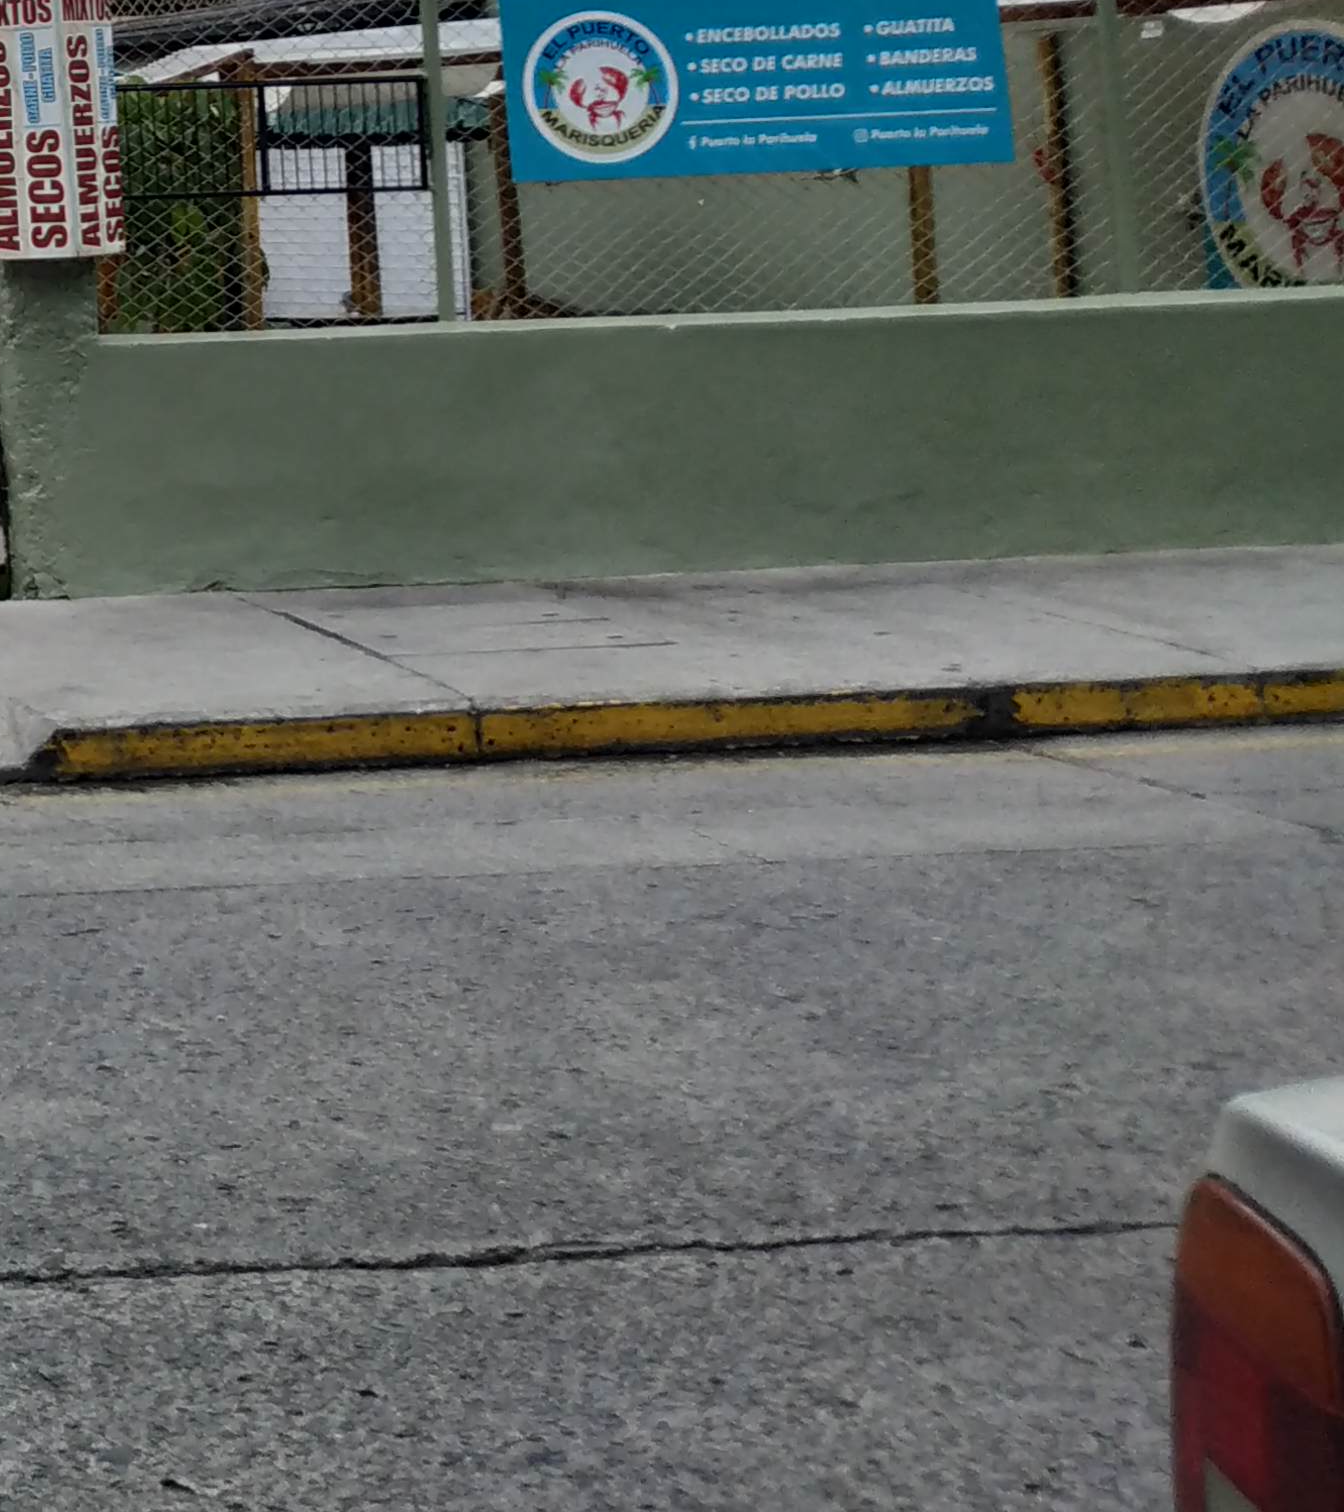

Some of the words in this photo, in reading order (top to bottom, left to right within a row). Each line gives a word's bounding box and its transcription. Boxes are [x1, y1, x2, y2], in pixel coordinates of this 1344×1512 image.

[542, 39, 568, 61] EL
[566, 21, 650, 56] PUERTO
[696, 22, 842, 44] ENCEBOLLADOS
[876, 17, 956, 36] GUATITA
[554, 51, 570, 72] LA
[570, 40, 644, 65] PARIHUELA
[700, 57, 748, 74] SECO
[752, 55, 776, 72] DE
[781, 53, 843, 70] CARNE
[879, 47, 977, 66] BANDERAS
[1255, 34, 1344, 76] PUER
[701, 87, 750, 104] SECO
[754, 85, 778, 101] DE
[783, 83, 846, 100] POLLO
[881, 76, 995, 96] ALMUERZOS
[66, 35, 102, 248] ALMUERZOS
[540, 105, 666, 147] MARISQUERIA
[26, 129, 68, 249] SECOS
[102, 125, 125, 244] SECOS
